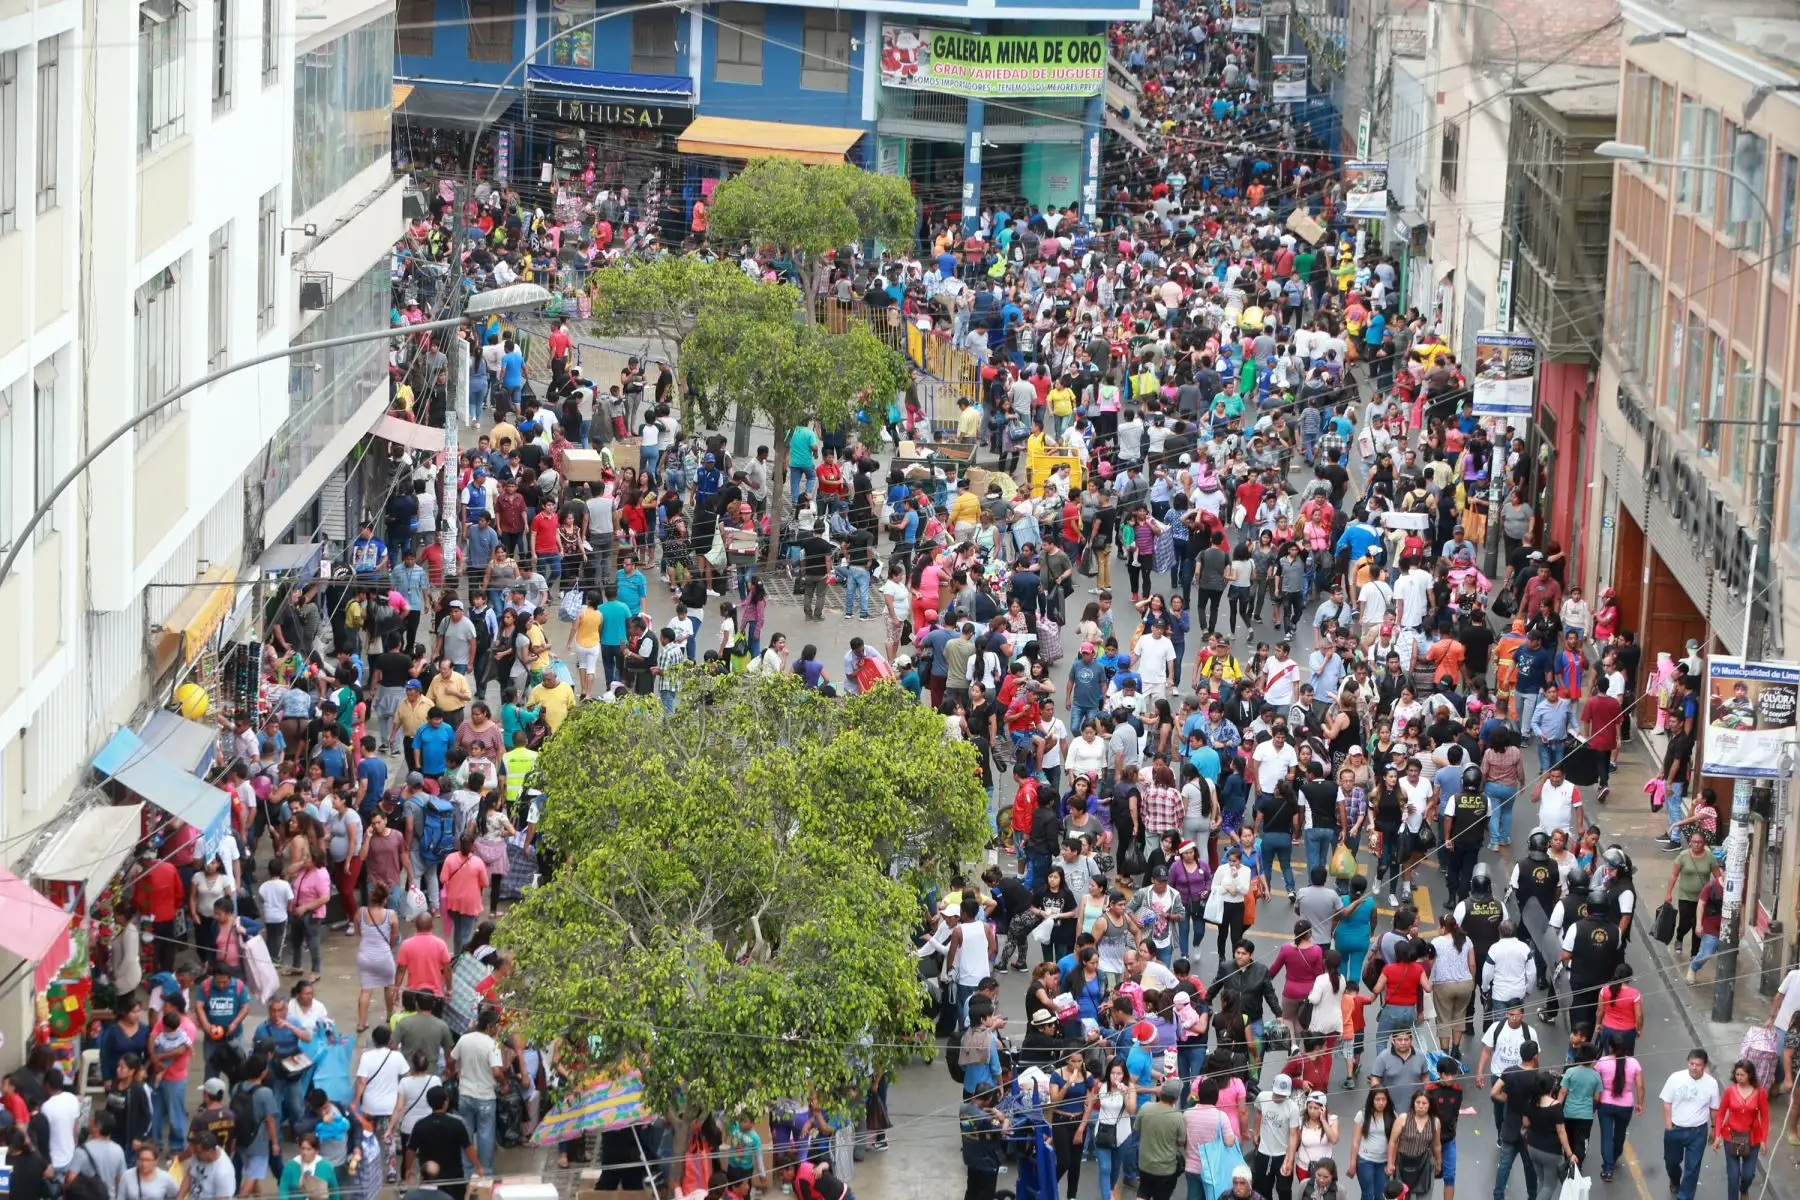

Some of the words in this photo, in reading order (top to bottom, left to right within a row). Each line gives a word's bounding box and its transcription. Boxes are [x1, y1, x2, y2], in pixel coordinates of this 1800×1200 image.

[934, 36, 992, 63] GALERIA
[997, 40, 1039, 64] MINA
[1043, 42, 1063, 63] DE
[1068, 42, 1101, 63] ORO
[934, 64, 966, 76] GRAN
[968, 67, 1028, 79] VARIEDAD
[1032, 68, 1047, 79] DE
[1050, 68, 1104, 79] JUGUETE
[913, 76, 939, 85] SOMOS
[999, 83, 1030, 91] TENEMOS
[1047, 83, 1077, 91] MEJORES
[1721, 667, 1770, 677] Municipalidad
[1758, 691, 1795, 704] PÓLVORA
[1461, 796, 1483, 804] G.F.C.
